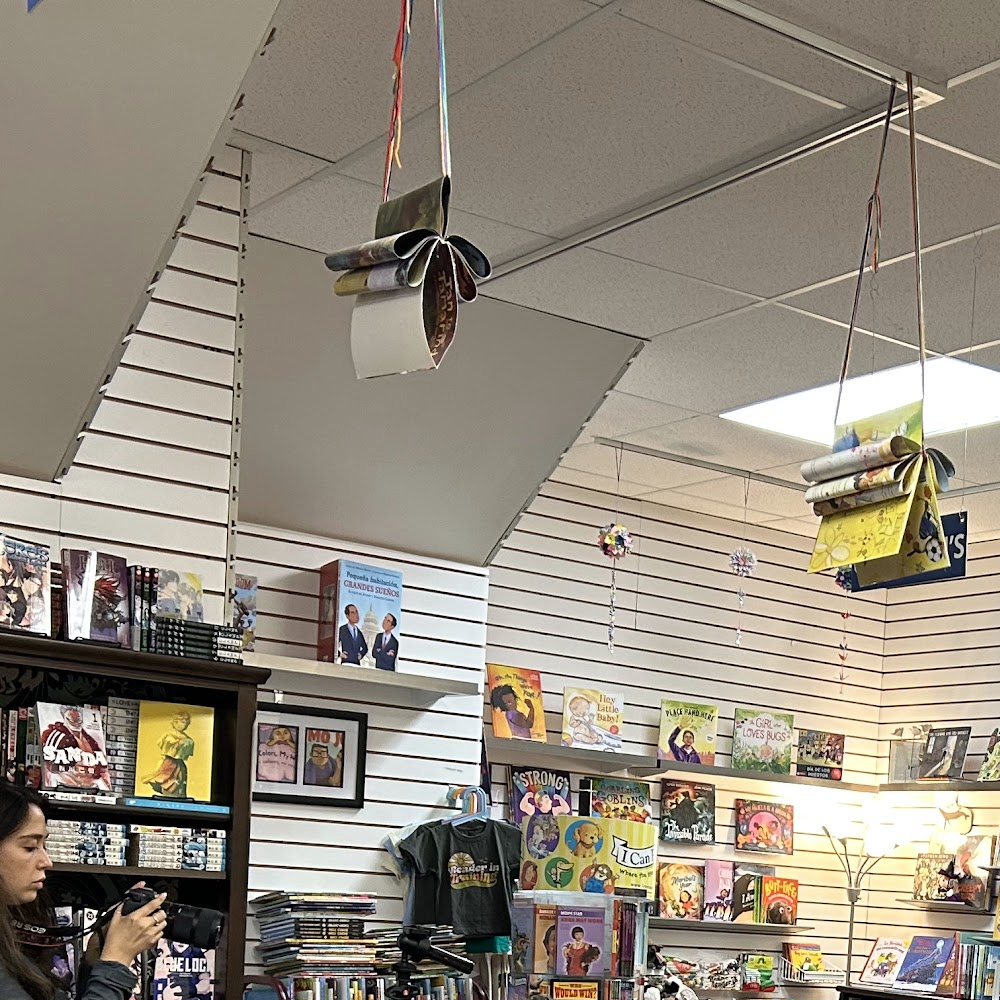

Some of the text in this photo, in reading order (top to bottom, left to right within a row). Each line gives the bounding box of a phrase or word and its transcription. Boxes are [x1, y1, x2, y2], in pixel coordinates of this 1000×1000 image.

[346, 571, 369, 582] Pequeña
[343, 580, 374, 593] GRANDES
[375, 586, 400, 598] SUEÑOS
[599, 694, 616, 704] Hey
[598, 705, 619, 714] Little
[666, 708, 715, 722] PLACE HAND HERE
[91, 713, 98, 723] 1
[597, 713, 620, 723] Baby!
[743, 728, 787, 742] LOVES BUGS
[43, 745, 108, 766] SANDA
[519, 770, 564, 790] STRONG
[621, 849, 651, 865] I Can
[451, 862, 500, 874] Reader in
[765, 879, 797, 896] BUTT-FACE
[554, 986, 597, 998] WOULD WIN?
